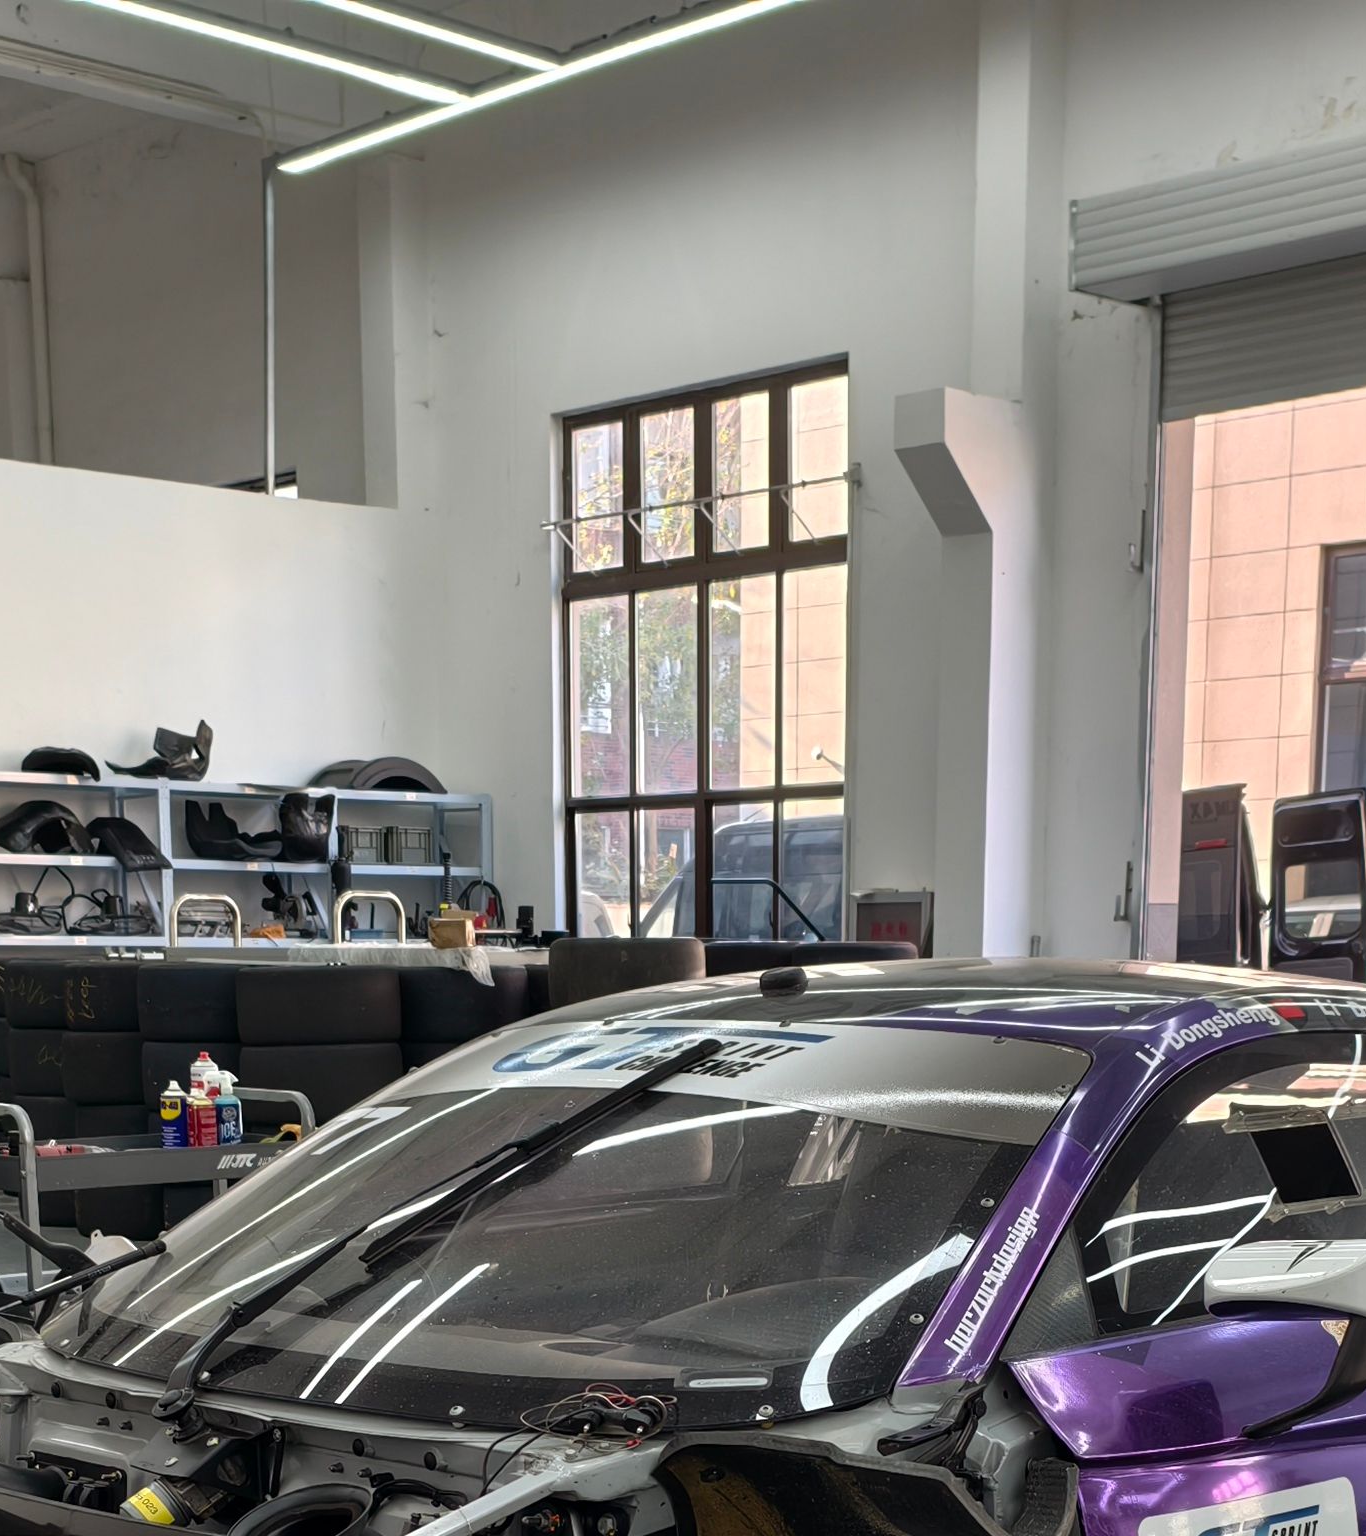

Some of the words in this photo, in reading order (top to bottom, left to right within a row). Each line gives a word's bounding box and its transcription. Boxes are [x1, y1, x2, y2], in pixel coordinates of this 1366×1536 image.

[1314, 997, 1341, 1016] Li
[1135, 1043, 1165, 1067] Li
[1161, 1003, 1280, 1050] Dongsheng
